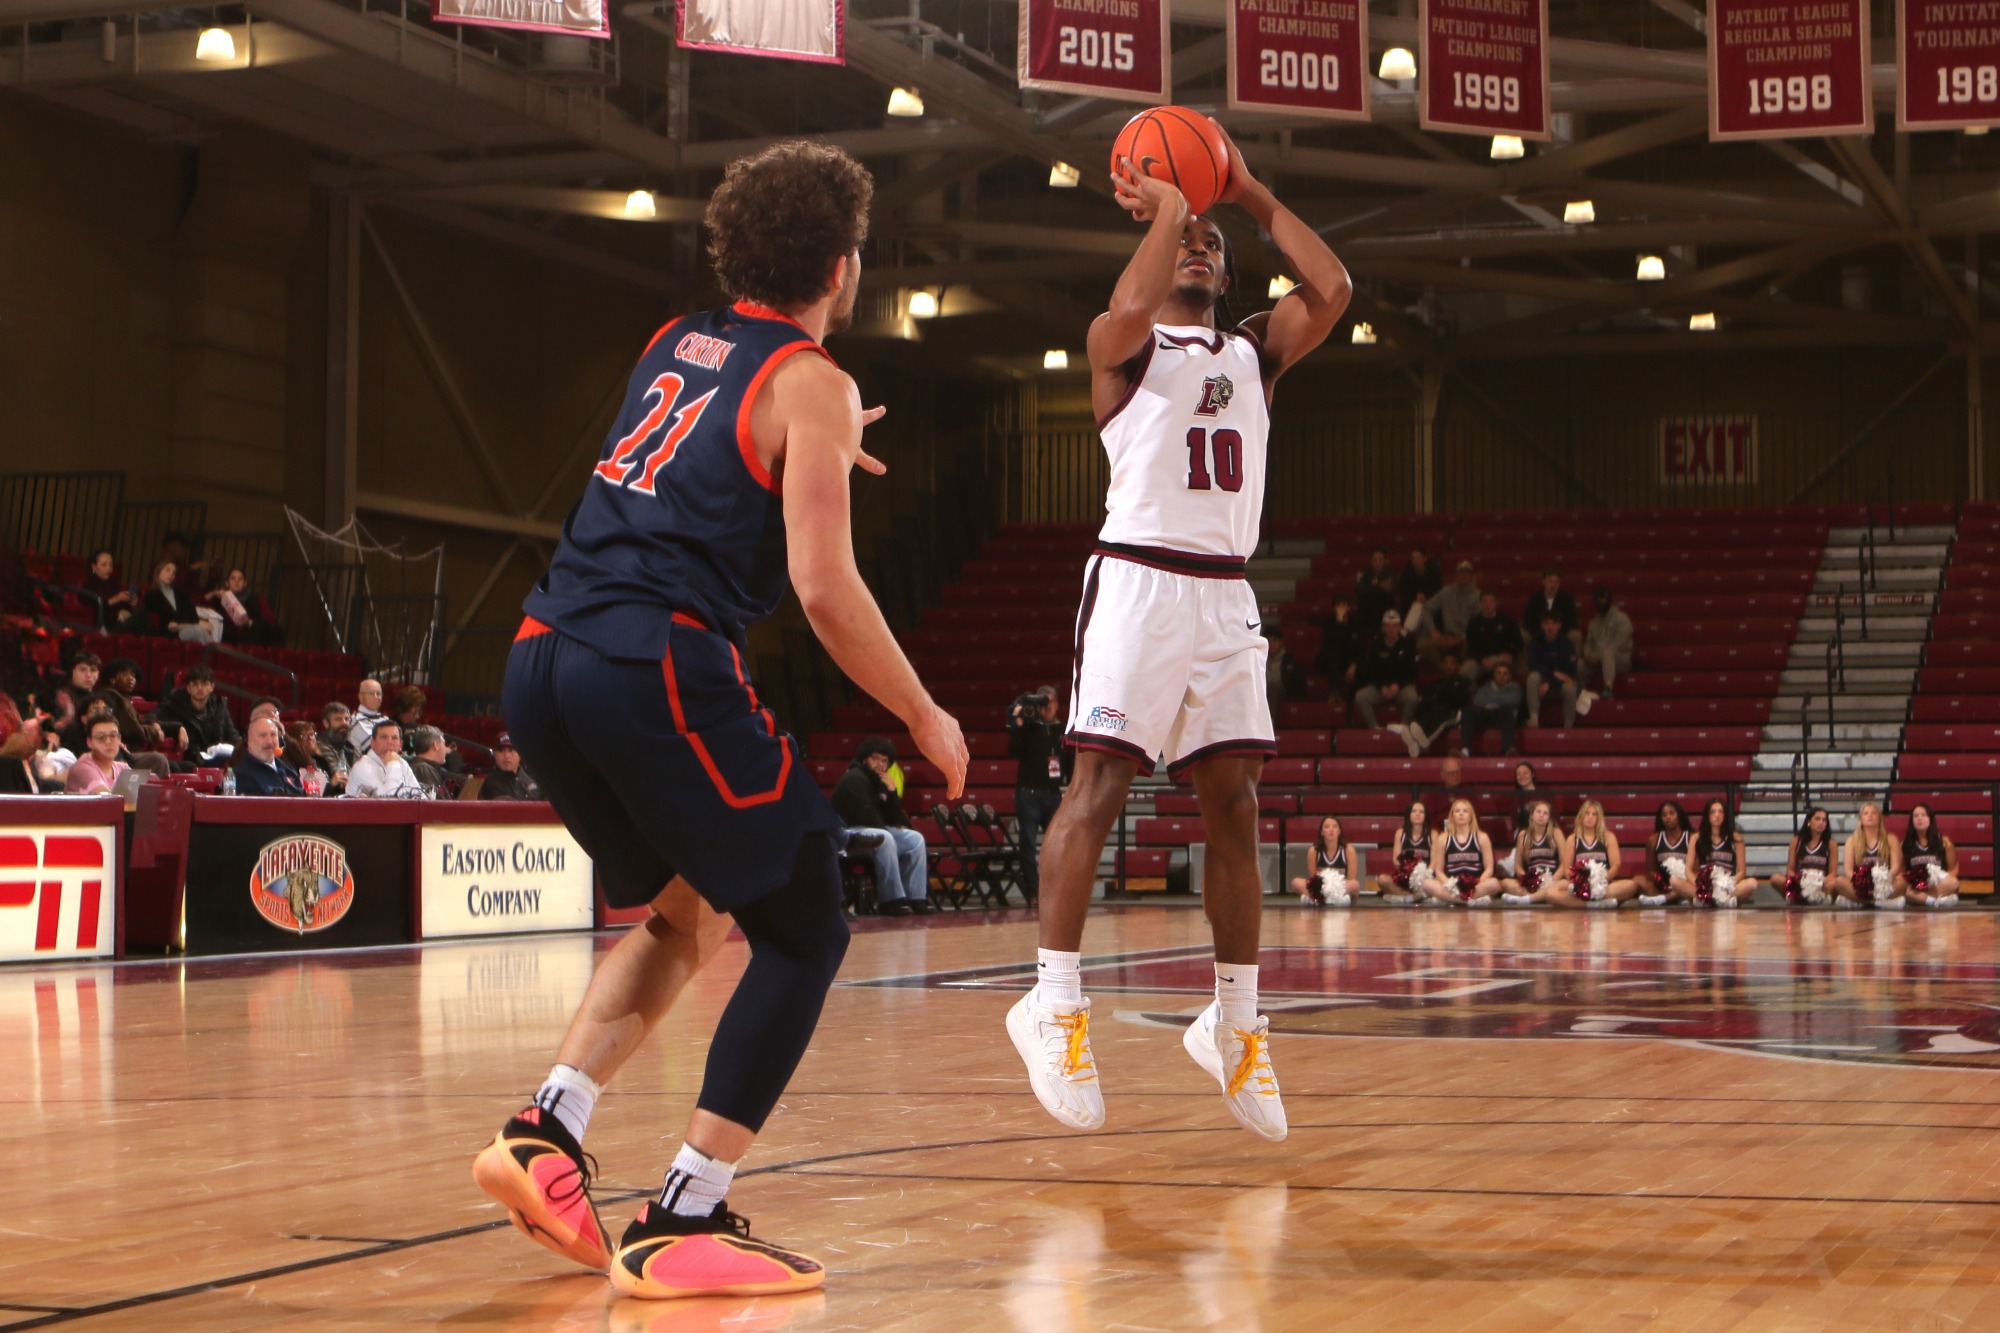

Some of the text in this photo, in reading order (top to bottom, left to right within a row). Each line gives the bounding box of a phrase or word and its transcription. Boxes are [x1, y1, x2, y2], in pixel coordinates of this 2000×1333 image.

[1053, 0, 1139, 18] CHAMPIONS
[1239, 0, 1355, 21] PATRIOT LEAGUE
[1726, 4, 1850, 25] PATRIOT LEAGUE
[1258, 16, 1340, 39] CHAMPIONS
[1432, 16, 1537, 45] PATRIOT LEAGUE
[1724, 23, 1852, 45] REGULAR SEASON
[1059, 26, 1134, 71] 2015
[1448, 40, 1523, 62] CHAMPIONS
[1746, 43, 1832, 63] CHAMPIONS
[1260, 49, 1339, 91] 2000
[1937, 65, 1998, 104] 198
[1453, 71, 1520, 112] 1999
[1749, 74, 1832, 114] 1998
[1194, 380, 1220, 418] L
[593, 371, 720, 497] 21
[1664, 424, 1750, 476] EXIT
[1186, 427, 1244, 493] 10
[1086, 721, 1127, 731] LEAGUE
[1087, 716, 1128, 727] PATRIOT
[261, 839, 344, 890] LAFAYETTE
[442, 842, 565, 875] EASTON COACH
[260, 889, 351, 923] SPORTS NETWORK
[467, 884, 541, 917] COMPANY
